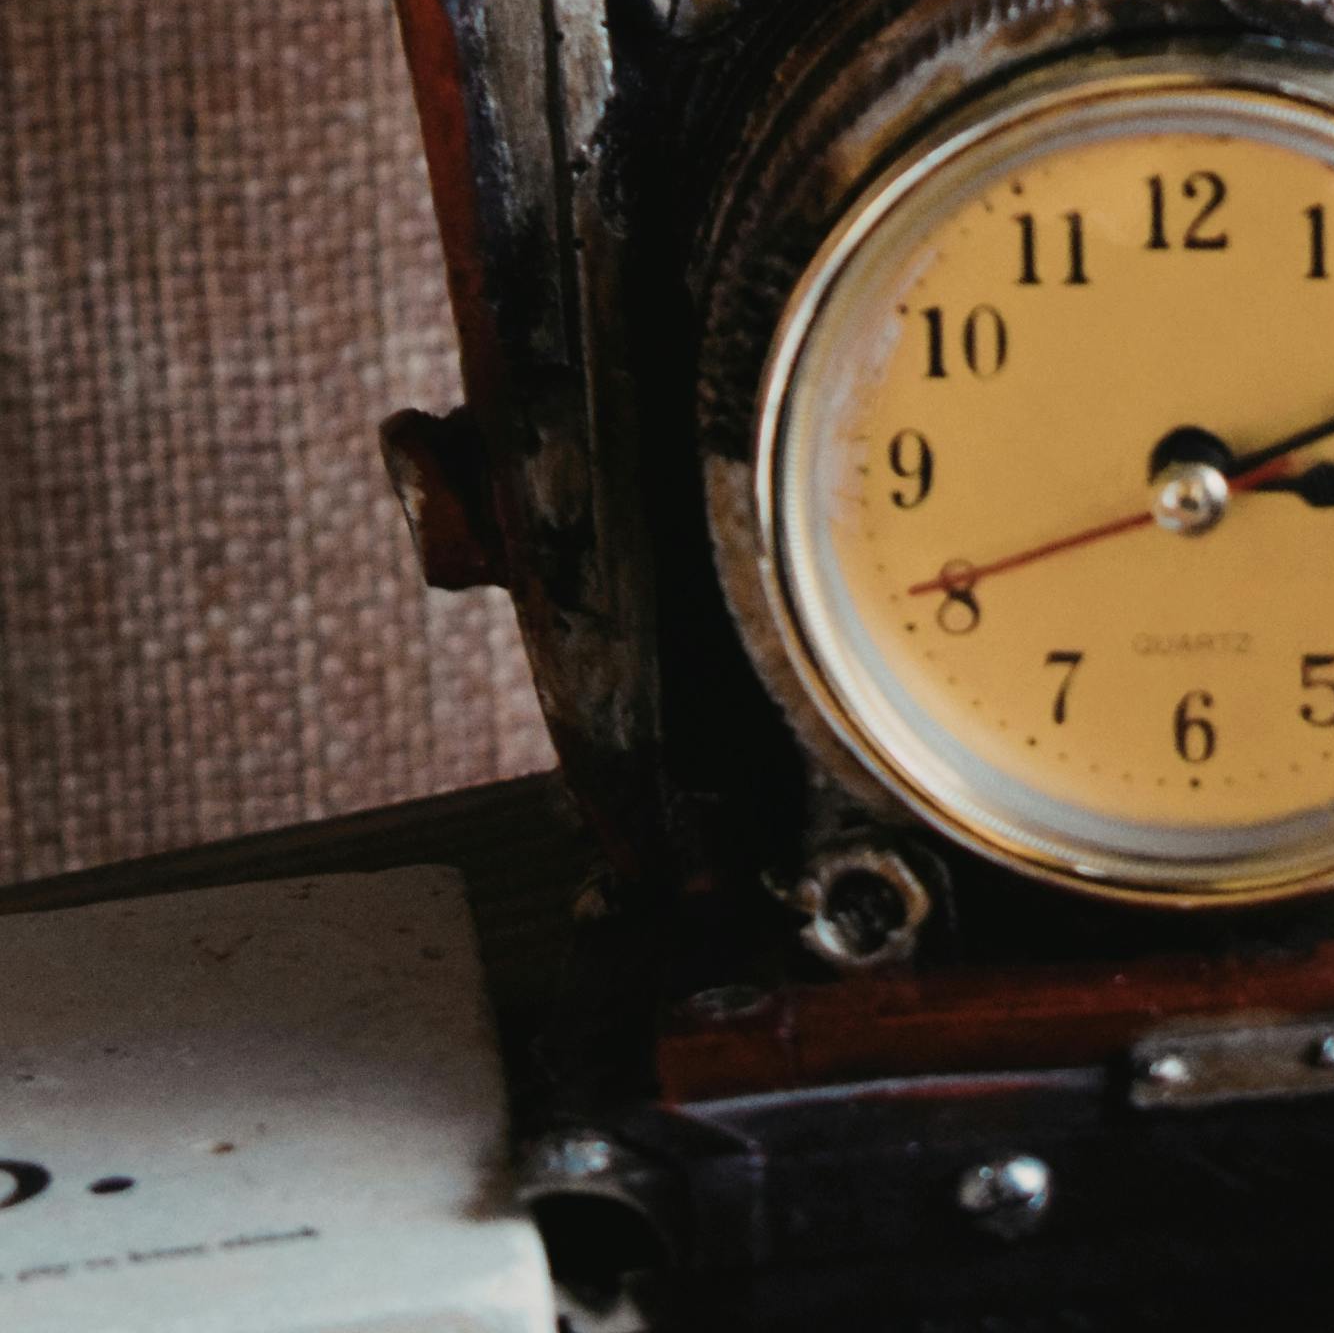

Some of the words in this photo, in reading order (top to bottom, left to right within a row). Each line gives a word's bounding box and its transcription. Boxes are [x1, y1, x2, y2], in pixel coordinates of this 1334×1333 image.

[1144, 171, 1230, 250] 12
[1303, 204, 1329, 280] 1
[1013, 212, 1091, 285] 11
[920, 306, 1009, 380] 10
[888, 429, 935, 508] 9
[936, 559, 982, 636] 8
[1130, 631, 1253, 656] QUARTZ
[1043, 652, 1084, 725] 7
[1172, 691, 1216, 764] 6
